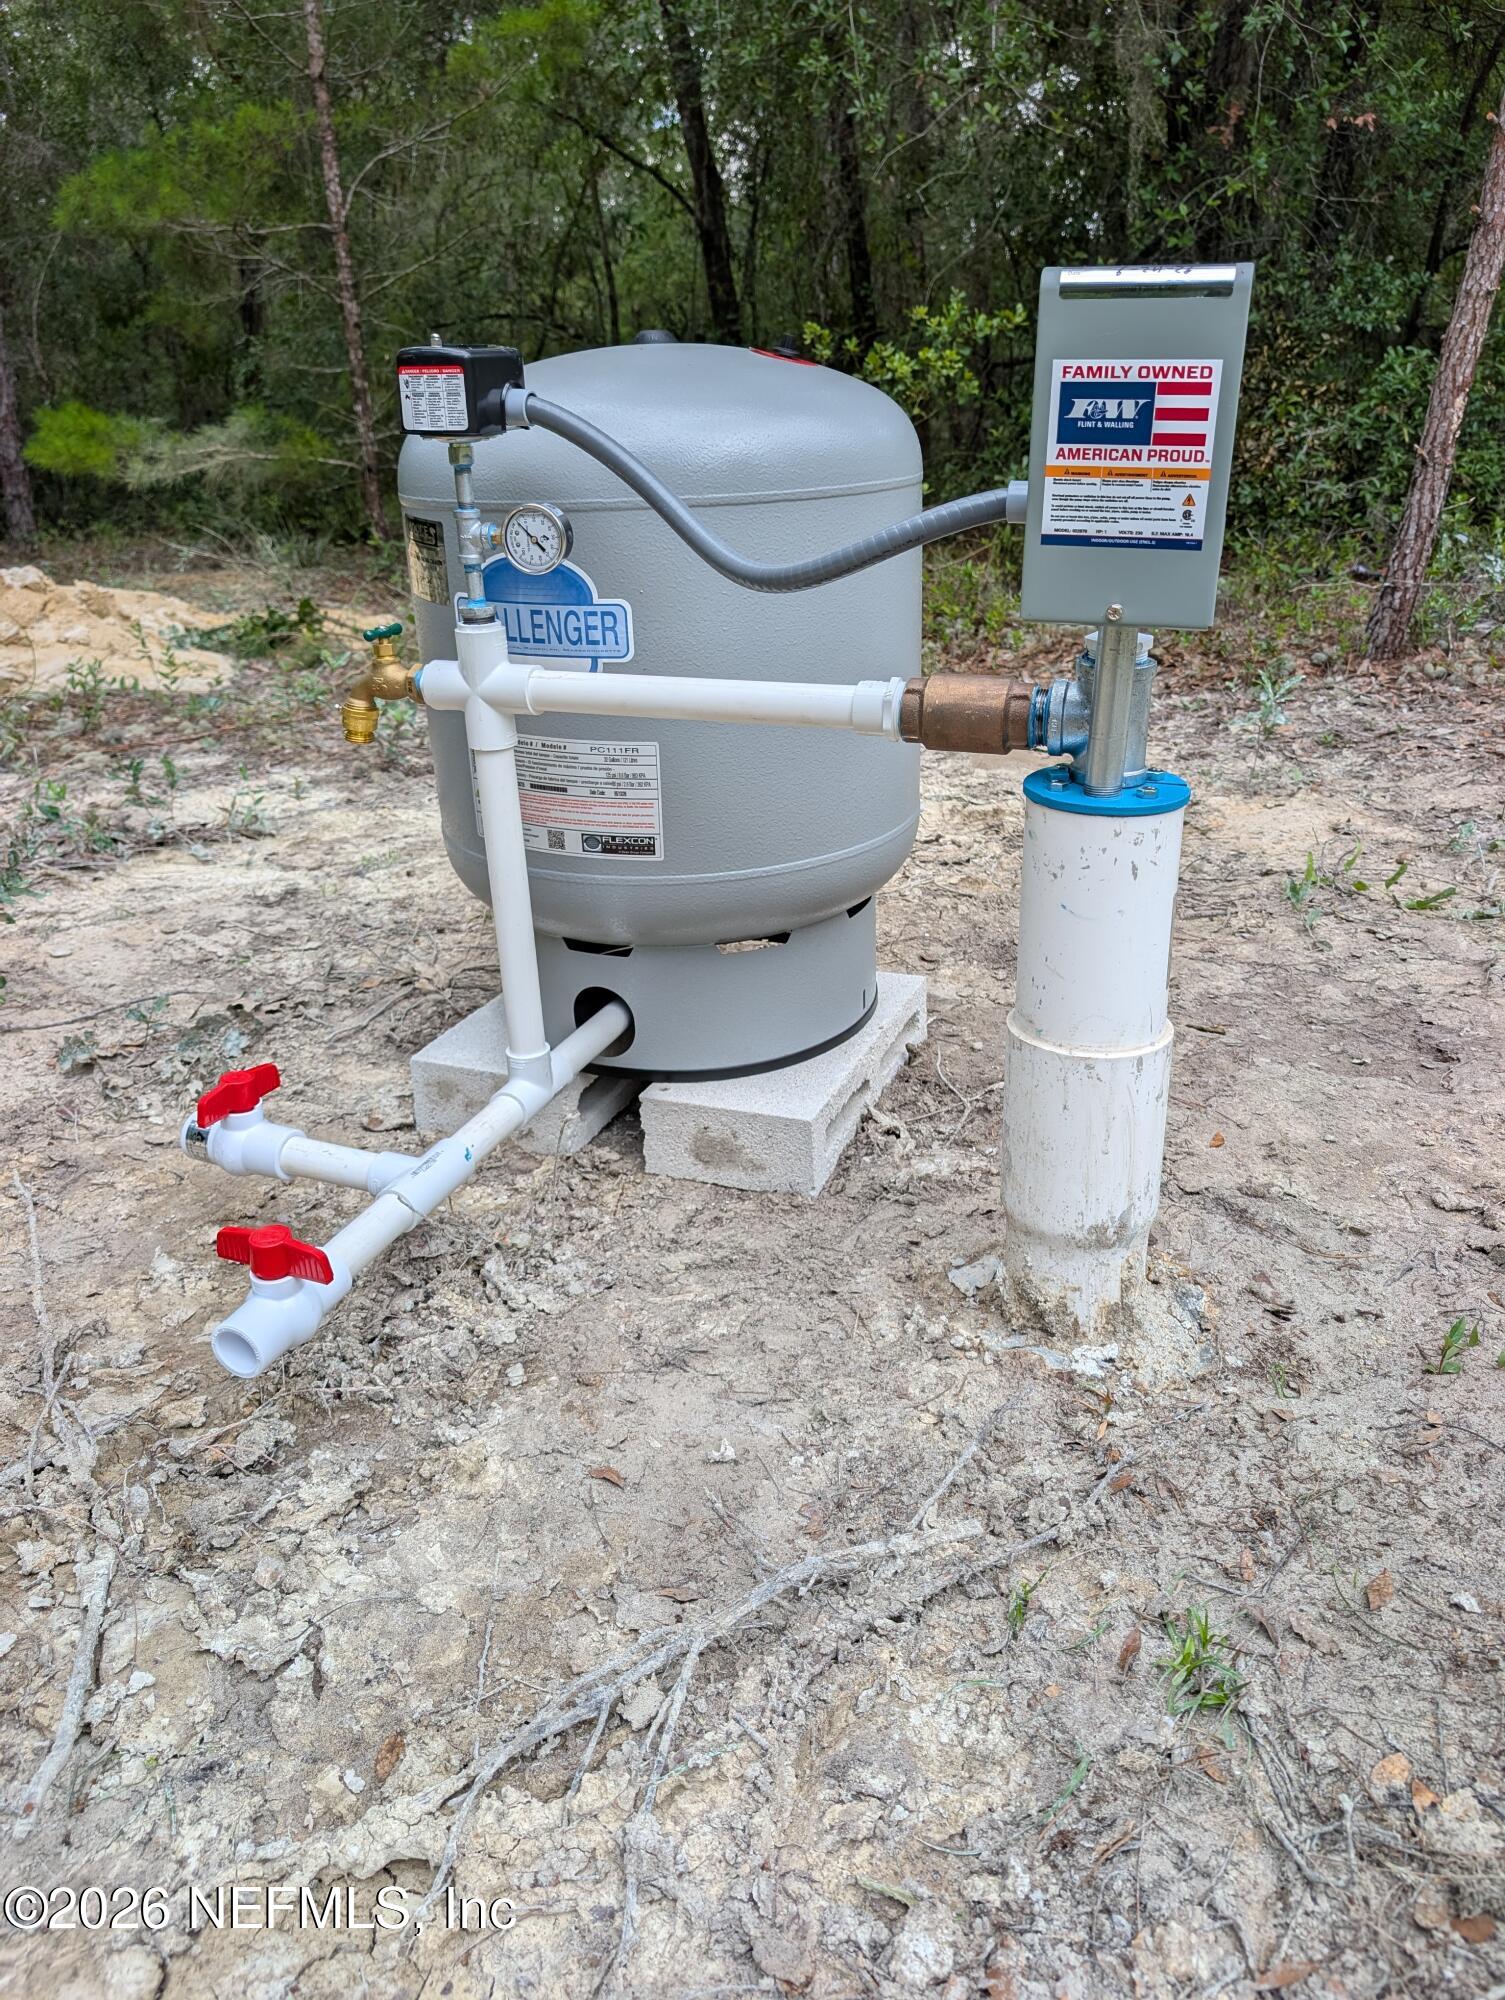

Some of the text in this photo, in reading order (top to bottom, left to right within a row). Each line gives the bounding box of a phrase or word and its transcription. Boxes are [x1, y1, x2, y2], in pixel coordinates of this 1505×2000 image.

[1062, 365, 1214, 379] FAMILY OWNED
[1104, 421, 1134, 429] WALLING
[1055, 447, 1143, 462] AMERICAN
[496, 607, 619, 646] LLENGER
[590, 746, 640, 754] PC111FR
[602, 836, 654, 845] FLEXCON
